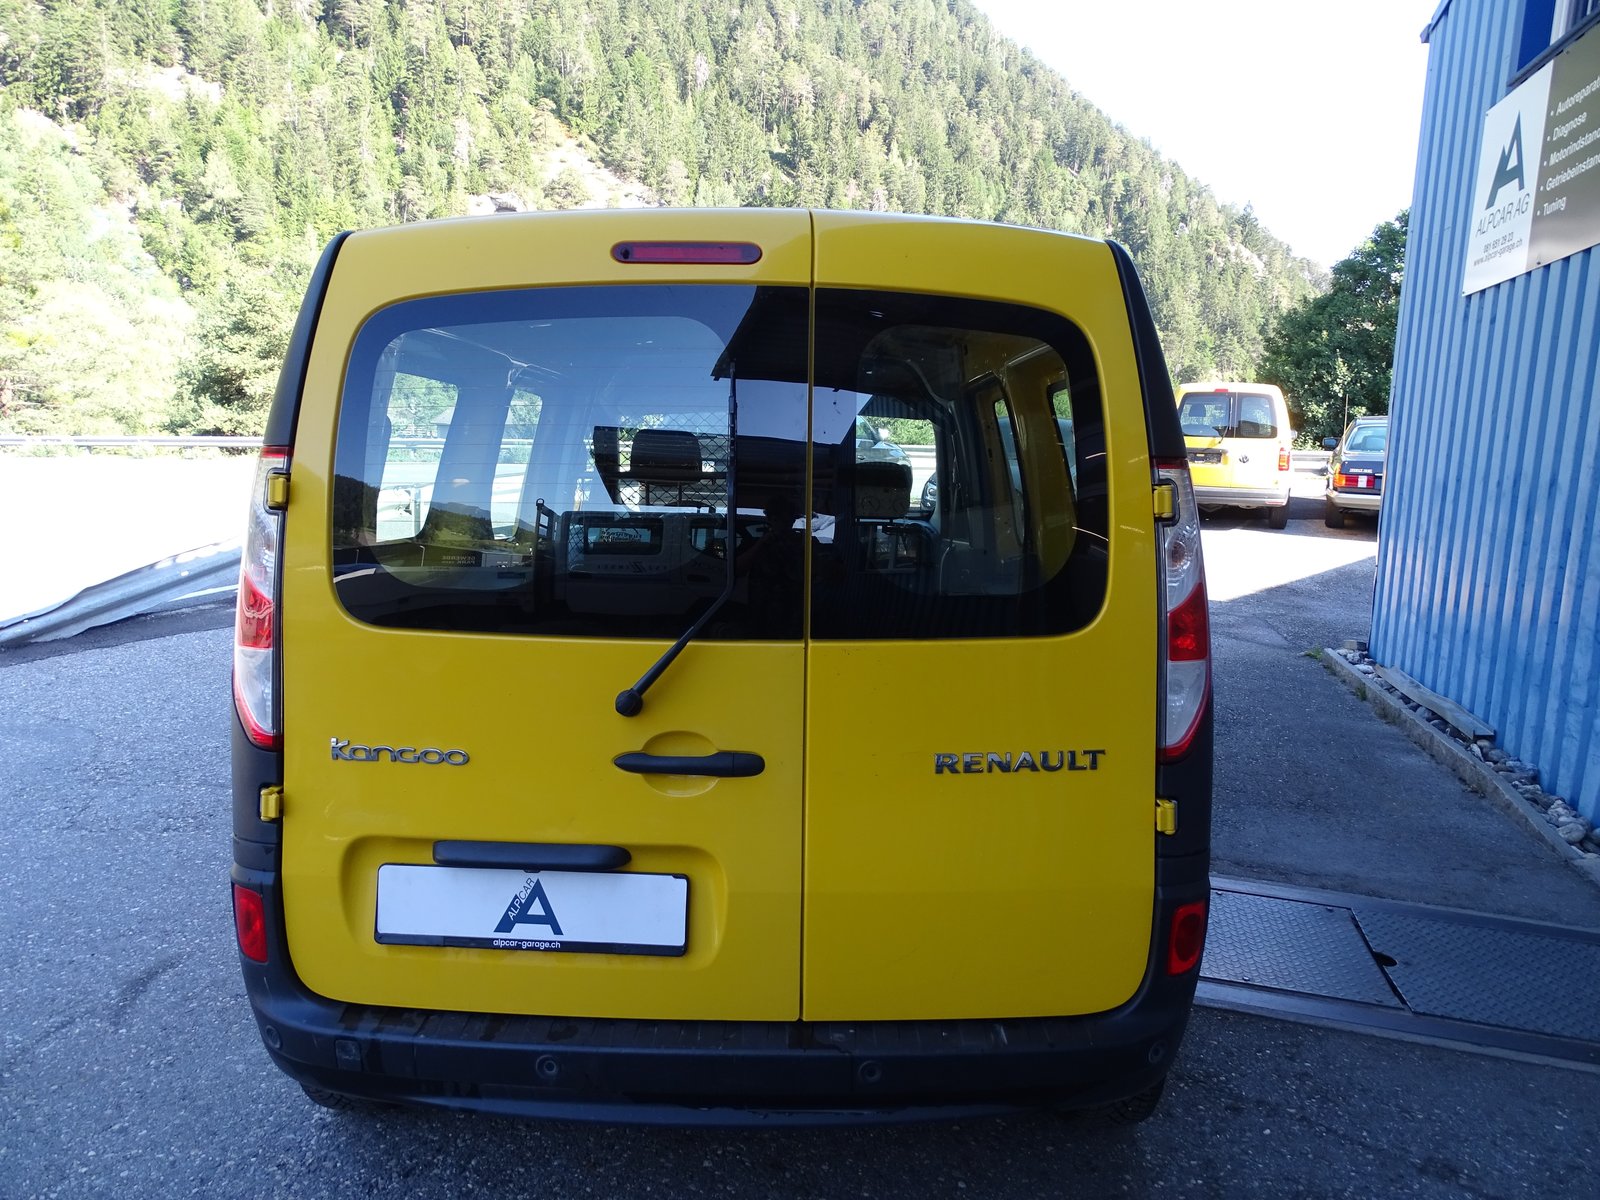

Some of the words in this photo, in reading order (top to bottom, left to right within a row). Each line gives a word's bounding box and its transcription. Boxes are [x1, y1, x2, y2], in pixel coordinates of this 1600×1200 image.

[1552, 111, 1587, 141] Diagnose
[1475, 200, 1513, 239] ALPCAR
[1513, 193, 1530, 219] AG
[1543, 195, 1567, 217] Tuning
[330, 737, 470, 766] Kangoo
[934, 749, 1106, 774] RENAULT
[508, 877, 535, 921] ALPCAR
[493, 939, 561, 950] alpcar-garage.ch
